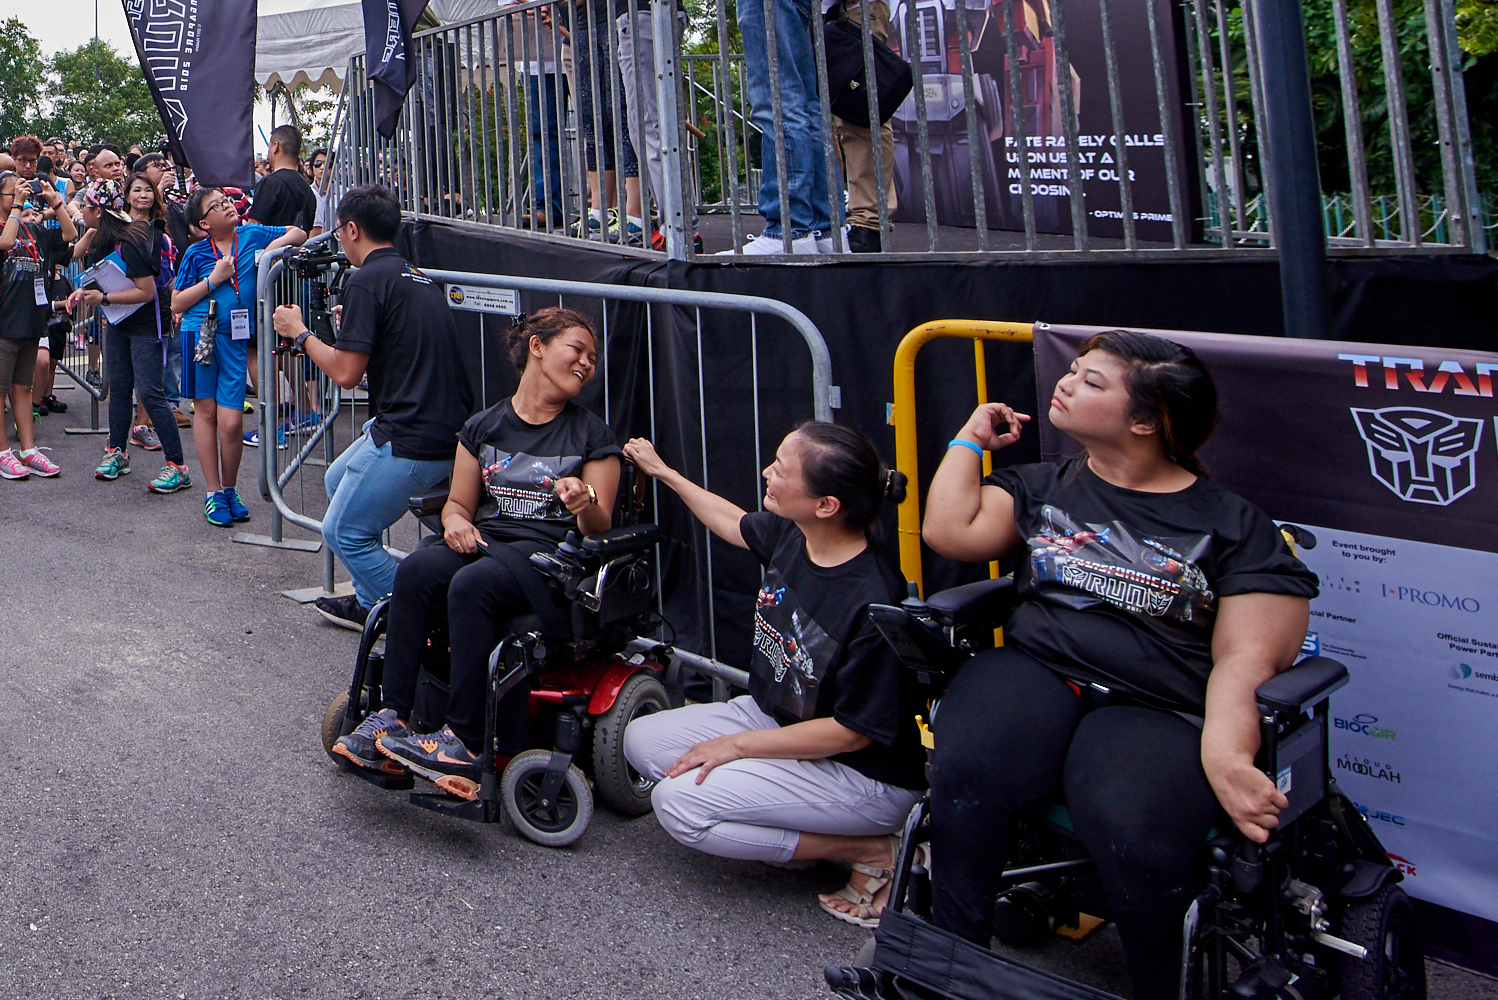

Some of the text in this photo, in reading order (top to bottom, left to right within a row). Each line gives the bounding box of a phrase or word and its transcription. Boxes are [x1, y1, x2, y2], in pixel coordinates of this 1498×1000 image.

[1005, 136, 1043, 148] FTE
[1045, 135, 1106, 147] RAELY
[1006, 152, 1046, 164] UON
[1100, 152, 1114, 164] A
[1008, 168, 1069, 180] MMENT
[1094, 210, 1139, 220] OPTIMS
[1140, 212, 1174, 222] PRIME
[501, 496, 536, 516] RUN
[1332, 540, 1396, 556] Event brought
[1342, 550, 1387, 564] to you by:
[1085, 572, 1147, 608] RUN
[1326, 612, 1356, 624] Partner
[1436, 632, 1469, 644] Official
[1449, 642, 1478, 654] Power
[1344, 753, 1391, 770] CLOUD
[1337, 758, 1401, 784] MOOLAH
[1370, 809, 1405, 826] JEC
